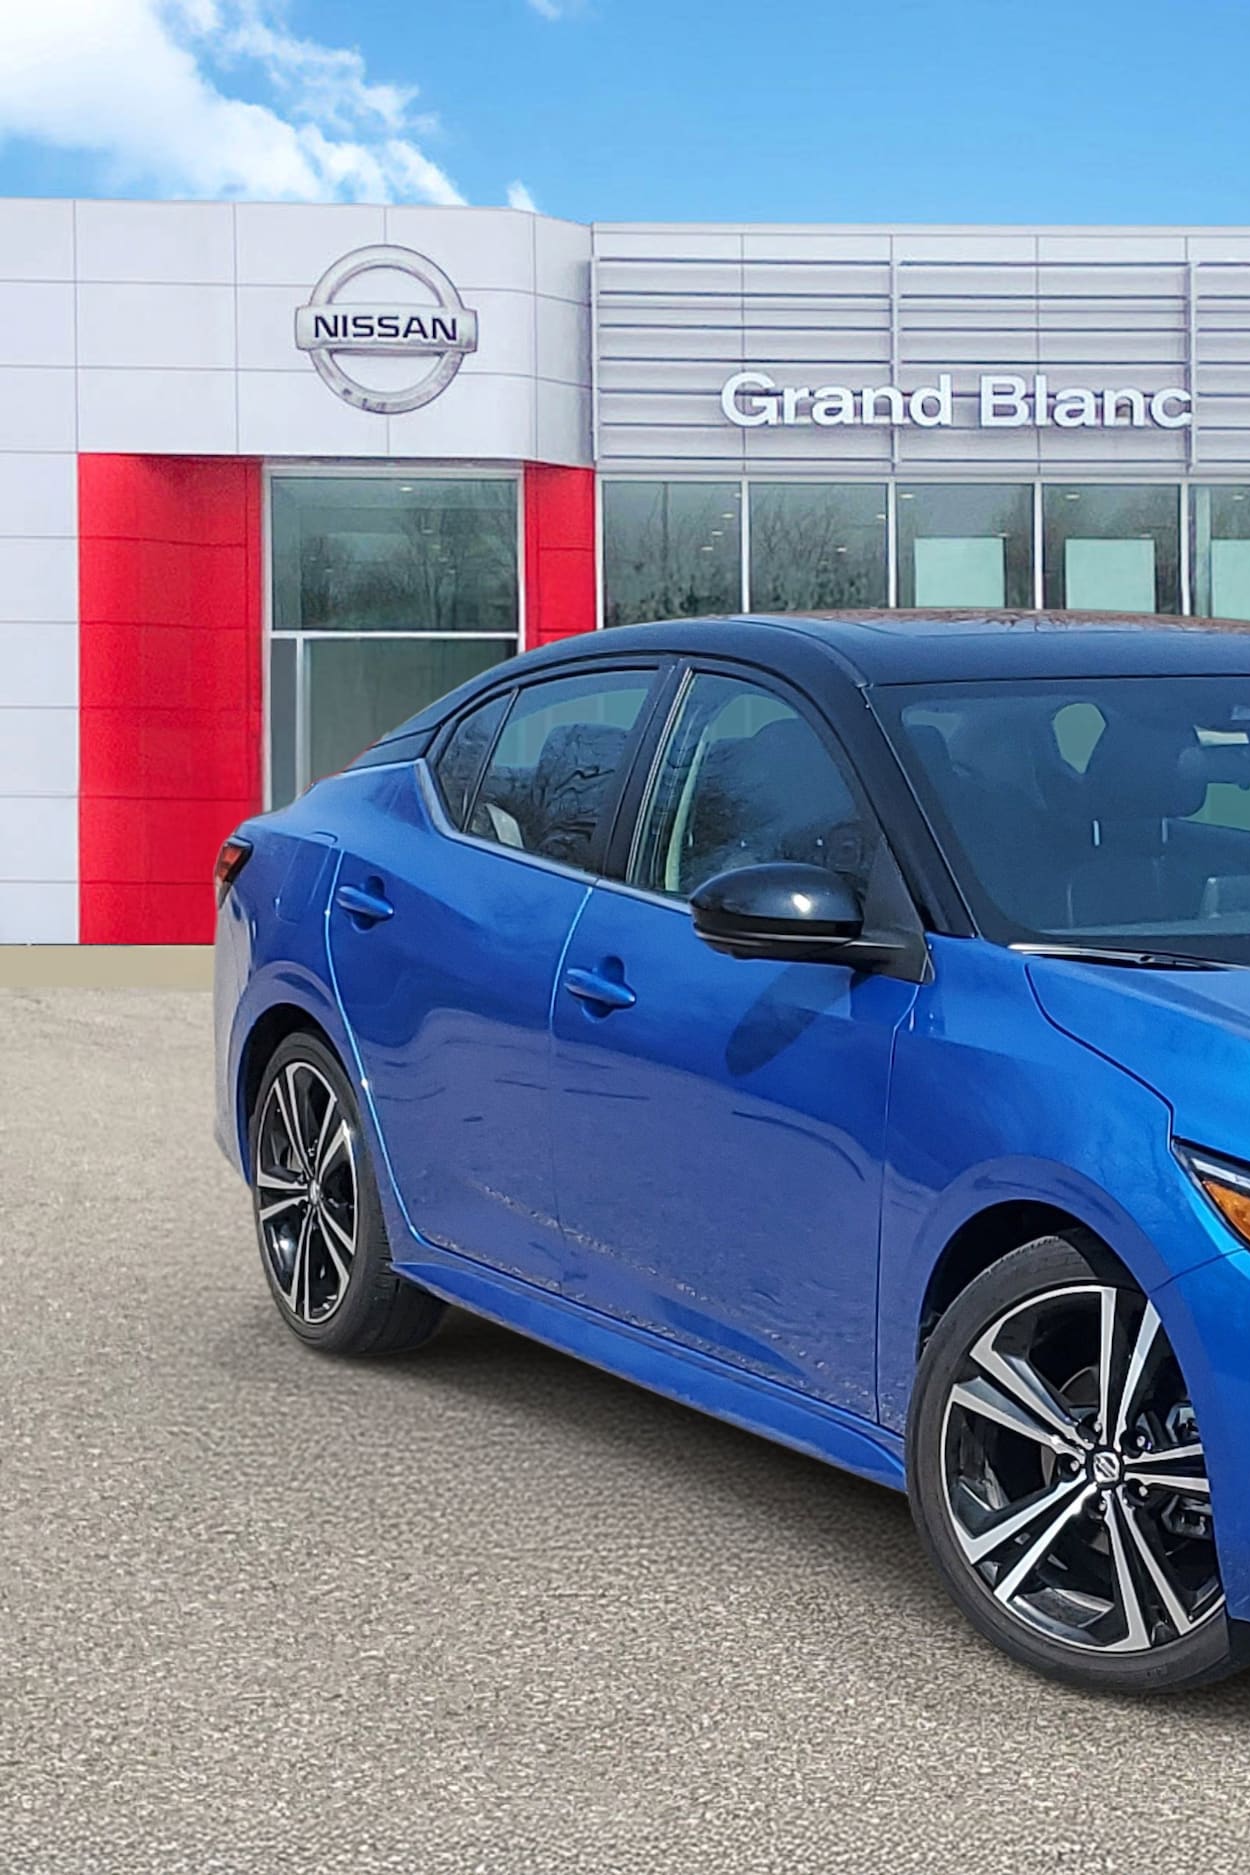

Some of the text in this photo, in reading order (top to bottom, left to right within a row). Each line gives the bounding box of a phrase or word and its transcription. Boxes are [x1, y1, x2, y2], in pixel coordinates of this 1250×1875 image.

[313, 314, 458, 342] NISSAN
[720, 371, 1193, 428] Grand Blanc
